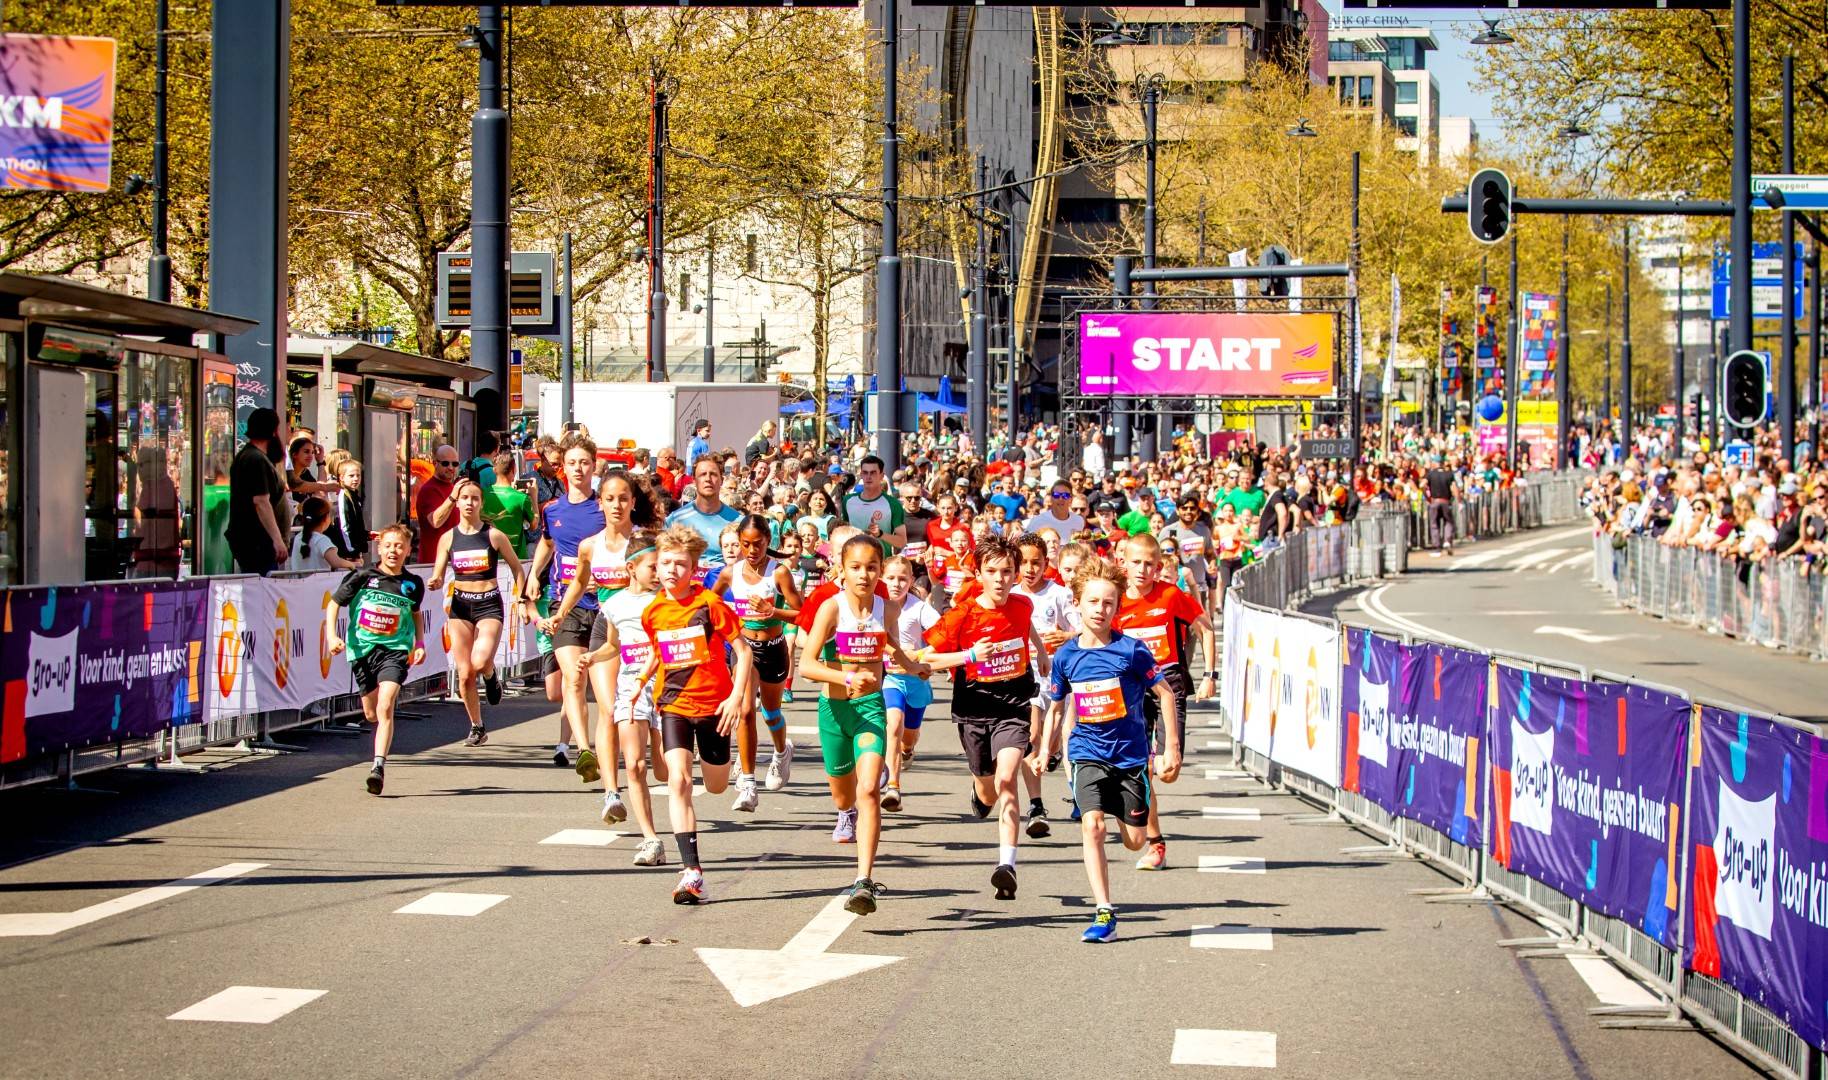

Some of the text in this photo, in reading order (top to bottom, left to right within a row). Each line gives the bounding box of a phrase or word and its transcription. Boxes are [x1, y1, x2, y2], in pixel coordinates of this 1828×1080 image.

[1356, 15, 1371, 25] OF
[1373, 15, 1410, 25] CHINA
[1132, 336, 1281, 372] START
[460, 590, 483, 600] NIKE
[363, 611, 395, 625] KEANO
[291, 628, 304, 658] NN
[625, 645, 650, 657] SOPH
[668, 642, 696, 654] IVAN
[847, 636, 878, 647] LENA
[32, 655, 72, 698] gro-up
[80, 652, 103, 685] Voor
[102, 647, 126, 686] kind,
[126, 644, 150, 691] gezin
[151, 654, 162, 677] en
[1079, 694, 1115, 707] AKSEL
[1555, 764, 1578, 812] Voor
[1577, 768, 1602, 829] kind,
[1638, 784, 1667, 843] buurt
[1720, 826, 1768, 903] gro-up
[1779, 847, 1828, 929] Voor ki
